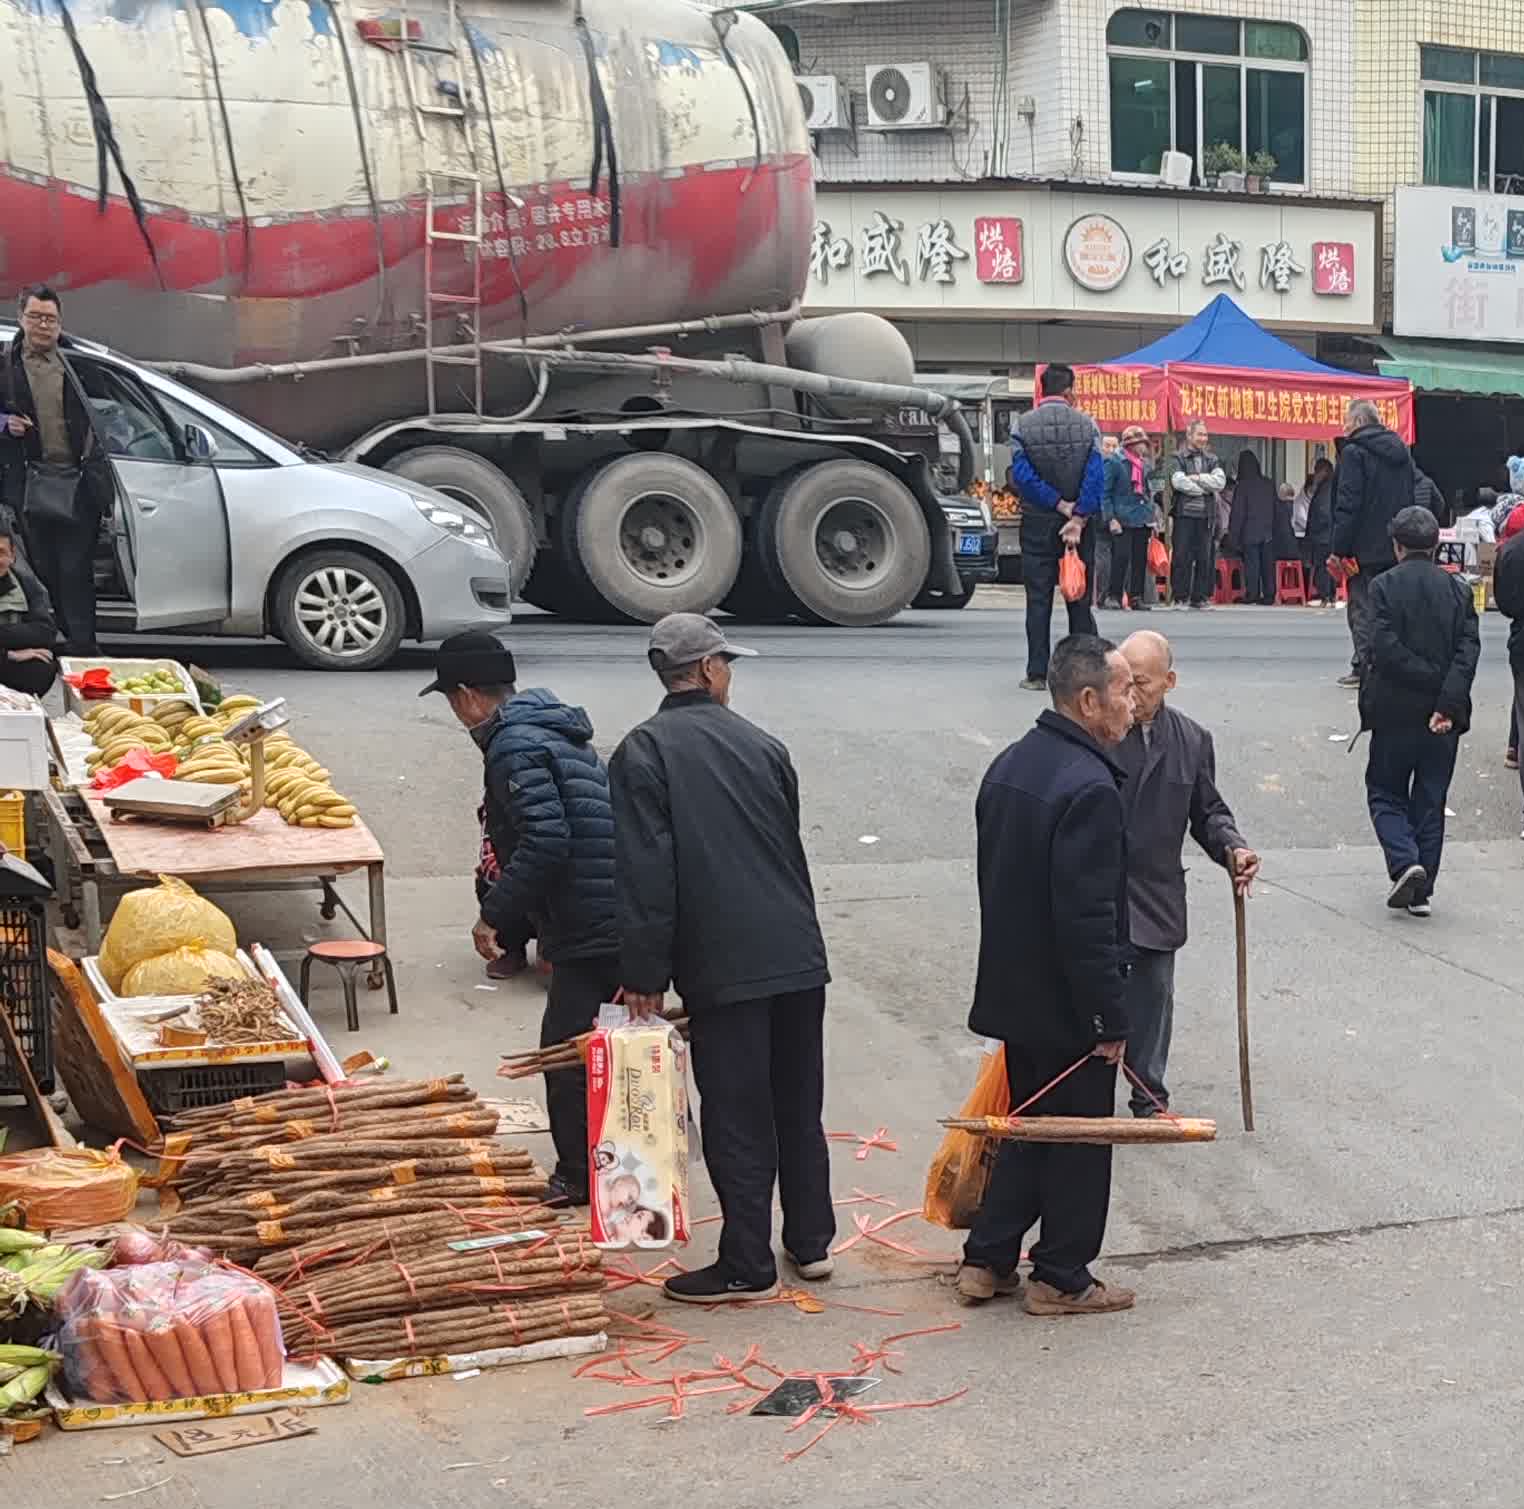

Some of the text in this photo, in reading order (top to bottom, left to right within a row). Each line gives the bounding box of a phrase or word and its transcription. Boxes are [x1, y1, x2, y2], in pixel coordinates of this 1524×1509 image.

[810, 211, 969, 284] 和盛隆
[979, 222, 1017, 280] 烘焙
[1143, 232, 1305, 294] 和盛隆
[1318, 245, 1352, 292] 烘焙
